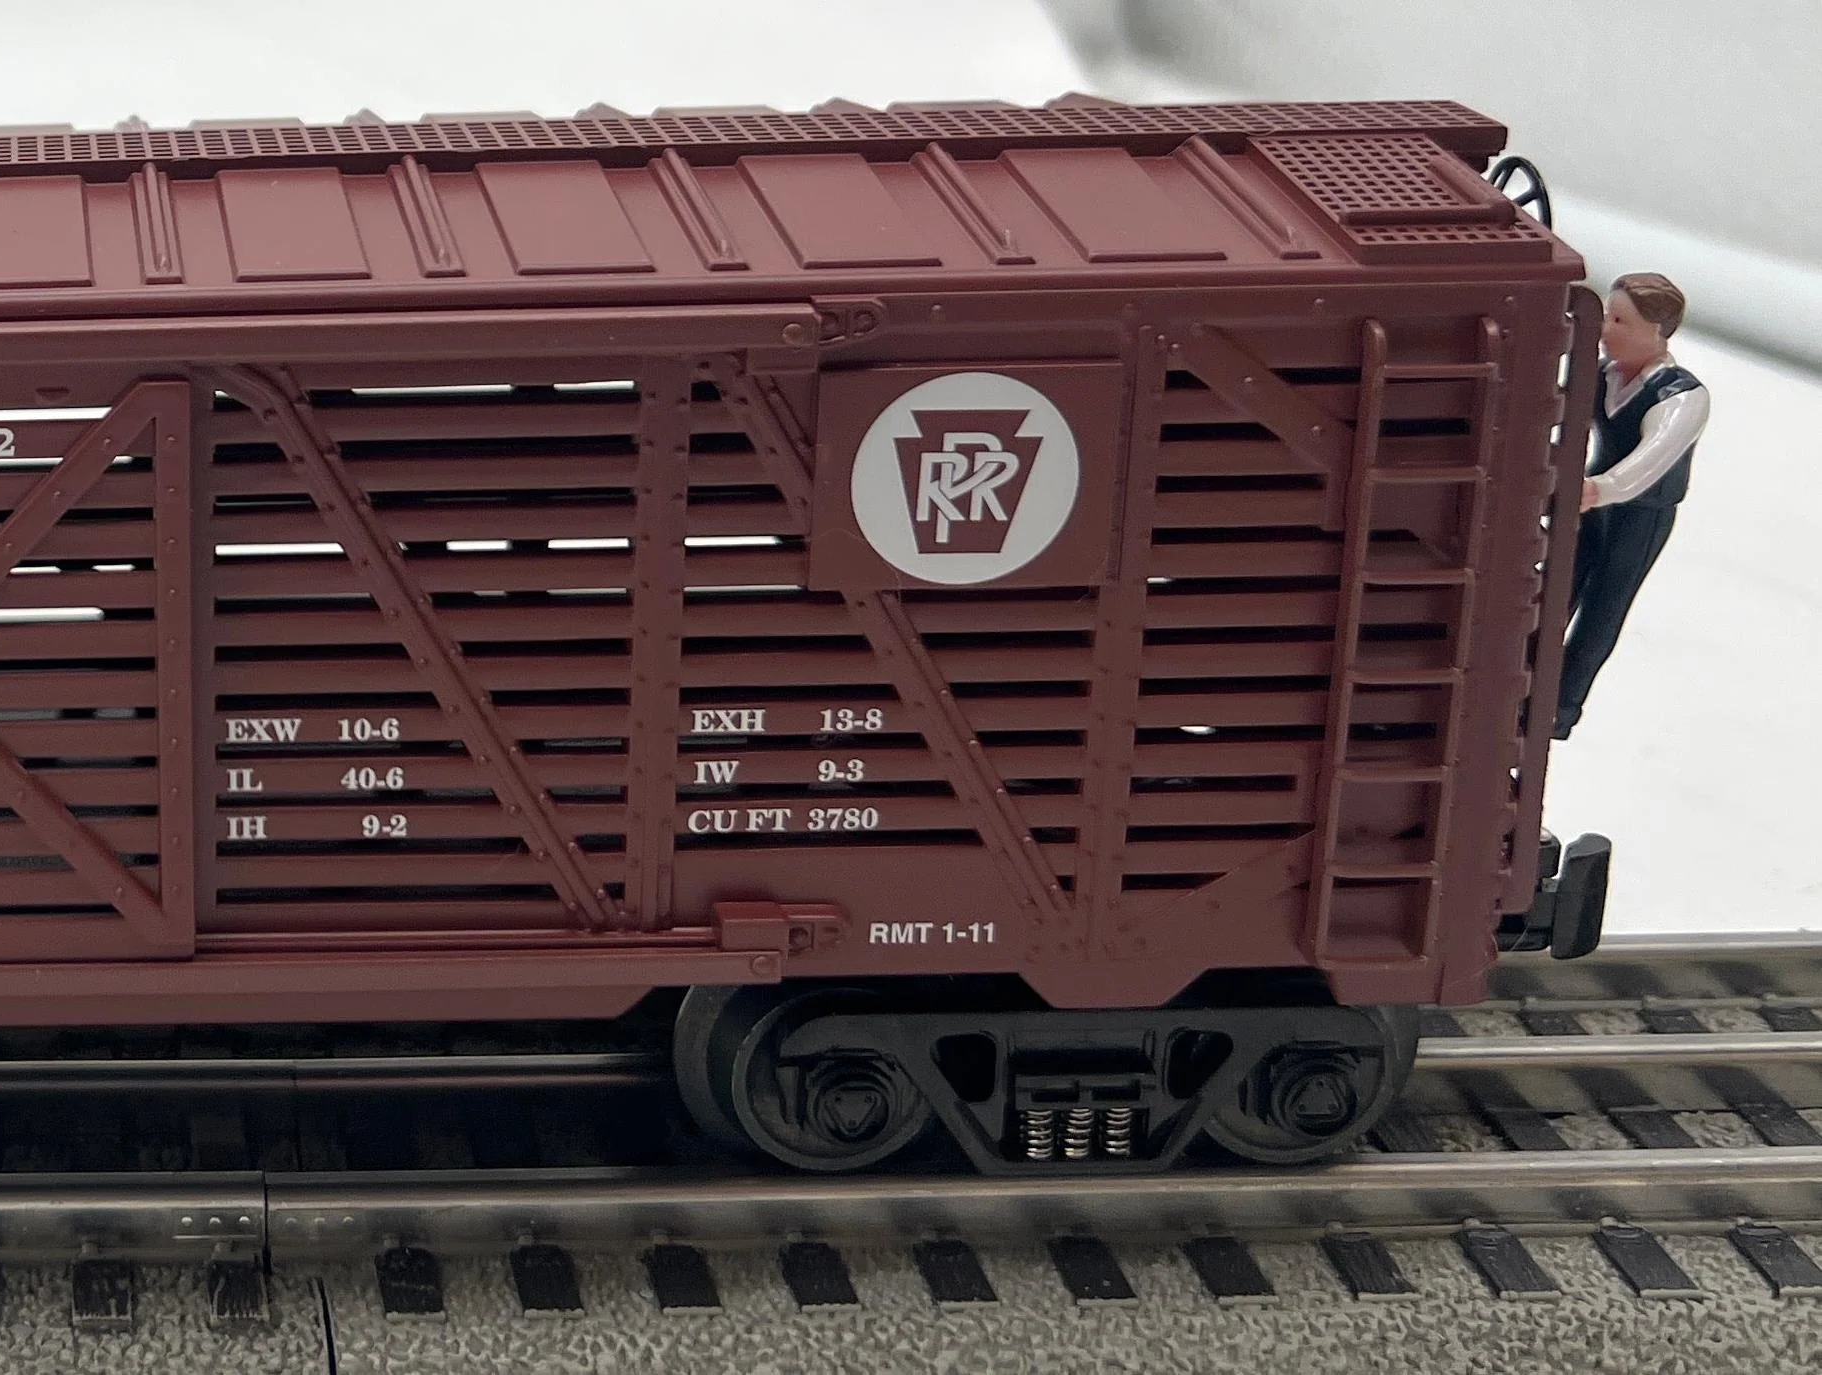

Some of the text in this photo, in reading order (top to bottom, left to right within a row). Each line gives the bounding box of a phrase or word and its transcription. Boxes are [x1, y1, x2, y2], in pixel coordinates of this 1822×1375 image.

[225, 717, 401, 745] EXW 10-6
[690, 706, 884, 736] EXH 13-8
[227, 766, 405, 795] IL 40-6
[693, 757, 865, 786] IW 9-3
[226, 814, 409, 841] IH 9-2
[687, 806, 880, 833] CU FT 3780
[868, 921, 997, 946] RMT 1-11
